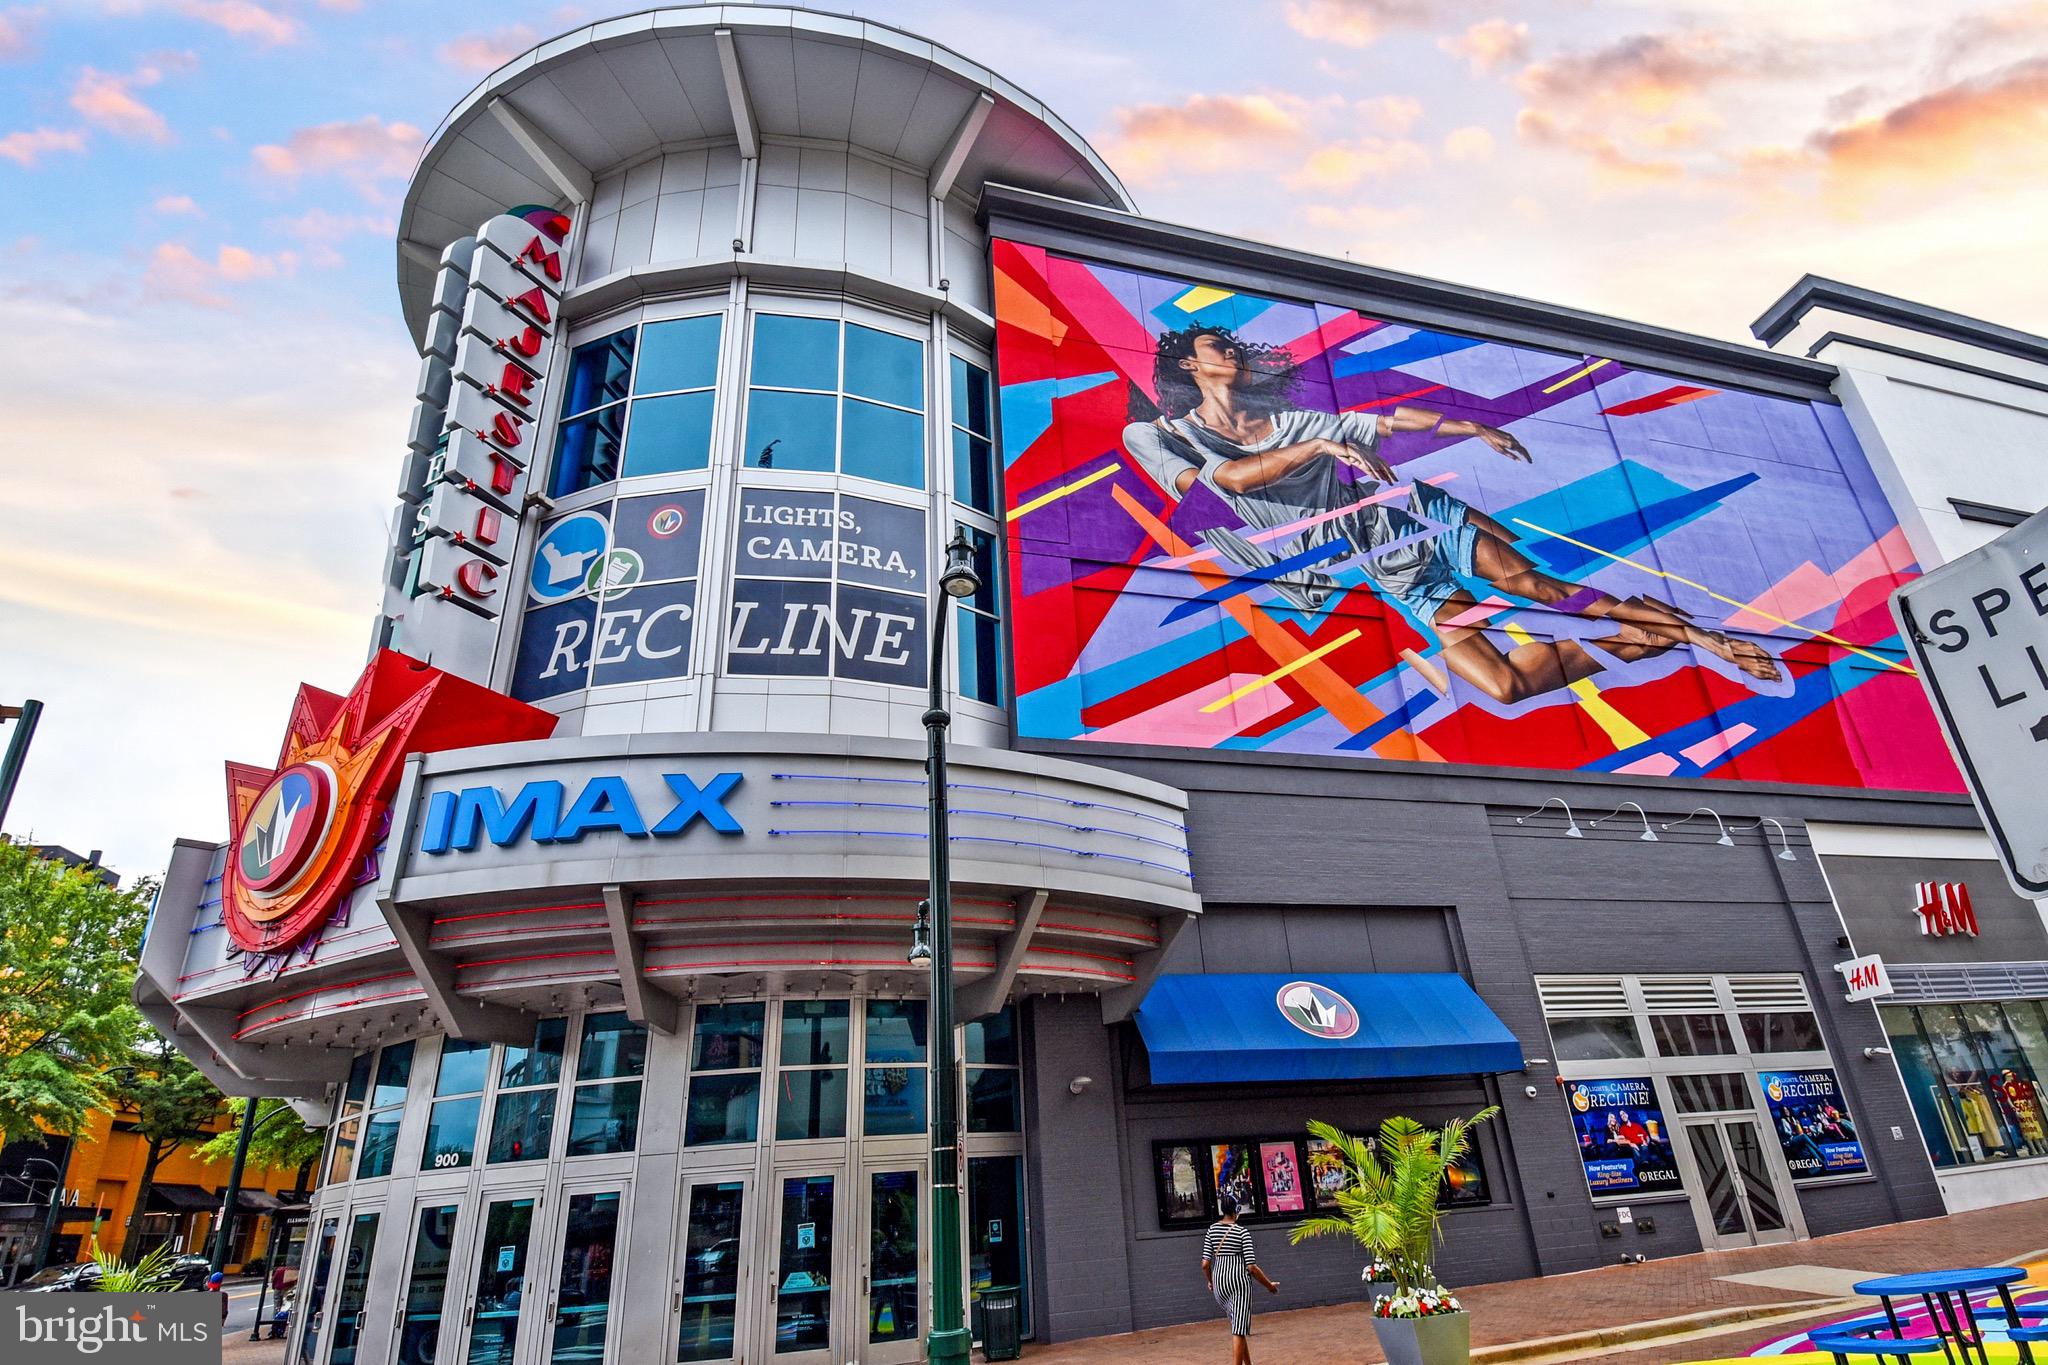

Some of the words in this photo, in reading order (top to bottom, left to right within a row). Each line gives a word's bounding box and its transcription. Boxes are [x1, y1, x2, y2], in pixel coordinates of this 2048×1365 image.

[458, 235, 563, 599] MAJESTIC
[744, 504, 862, 534] LIGHTS,
[746, 536, 917, 579] CAMERA,
[421, 772, 745, 855] IMAX
[1912, 880, 1981, 938] H&M
[1849, 962, 1879, 992] H&M
[1610, 1082, 1650, 1092] CAMERA,
[1799, 1074, 1833, 1083] CAMERA,
[1590, 1091, 1650, 1108] RECLINE!
[1782, 1083, 1834, 1098] RECLINE!
[434, 1152, 459, 1168] 900
[1796, 1159, 1823, 1169] REGAL
[1648, 1170, 1678, 1181] REGAL
[50, 1187, 80, 1207] AVA
